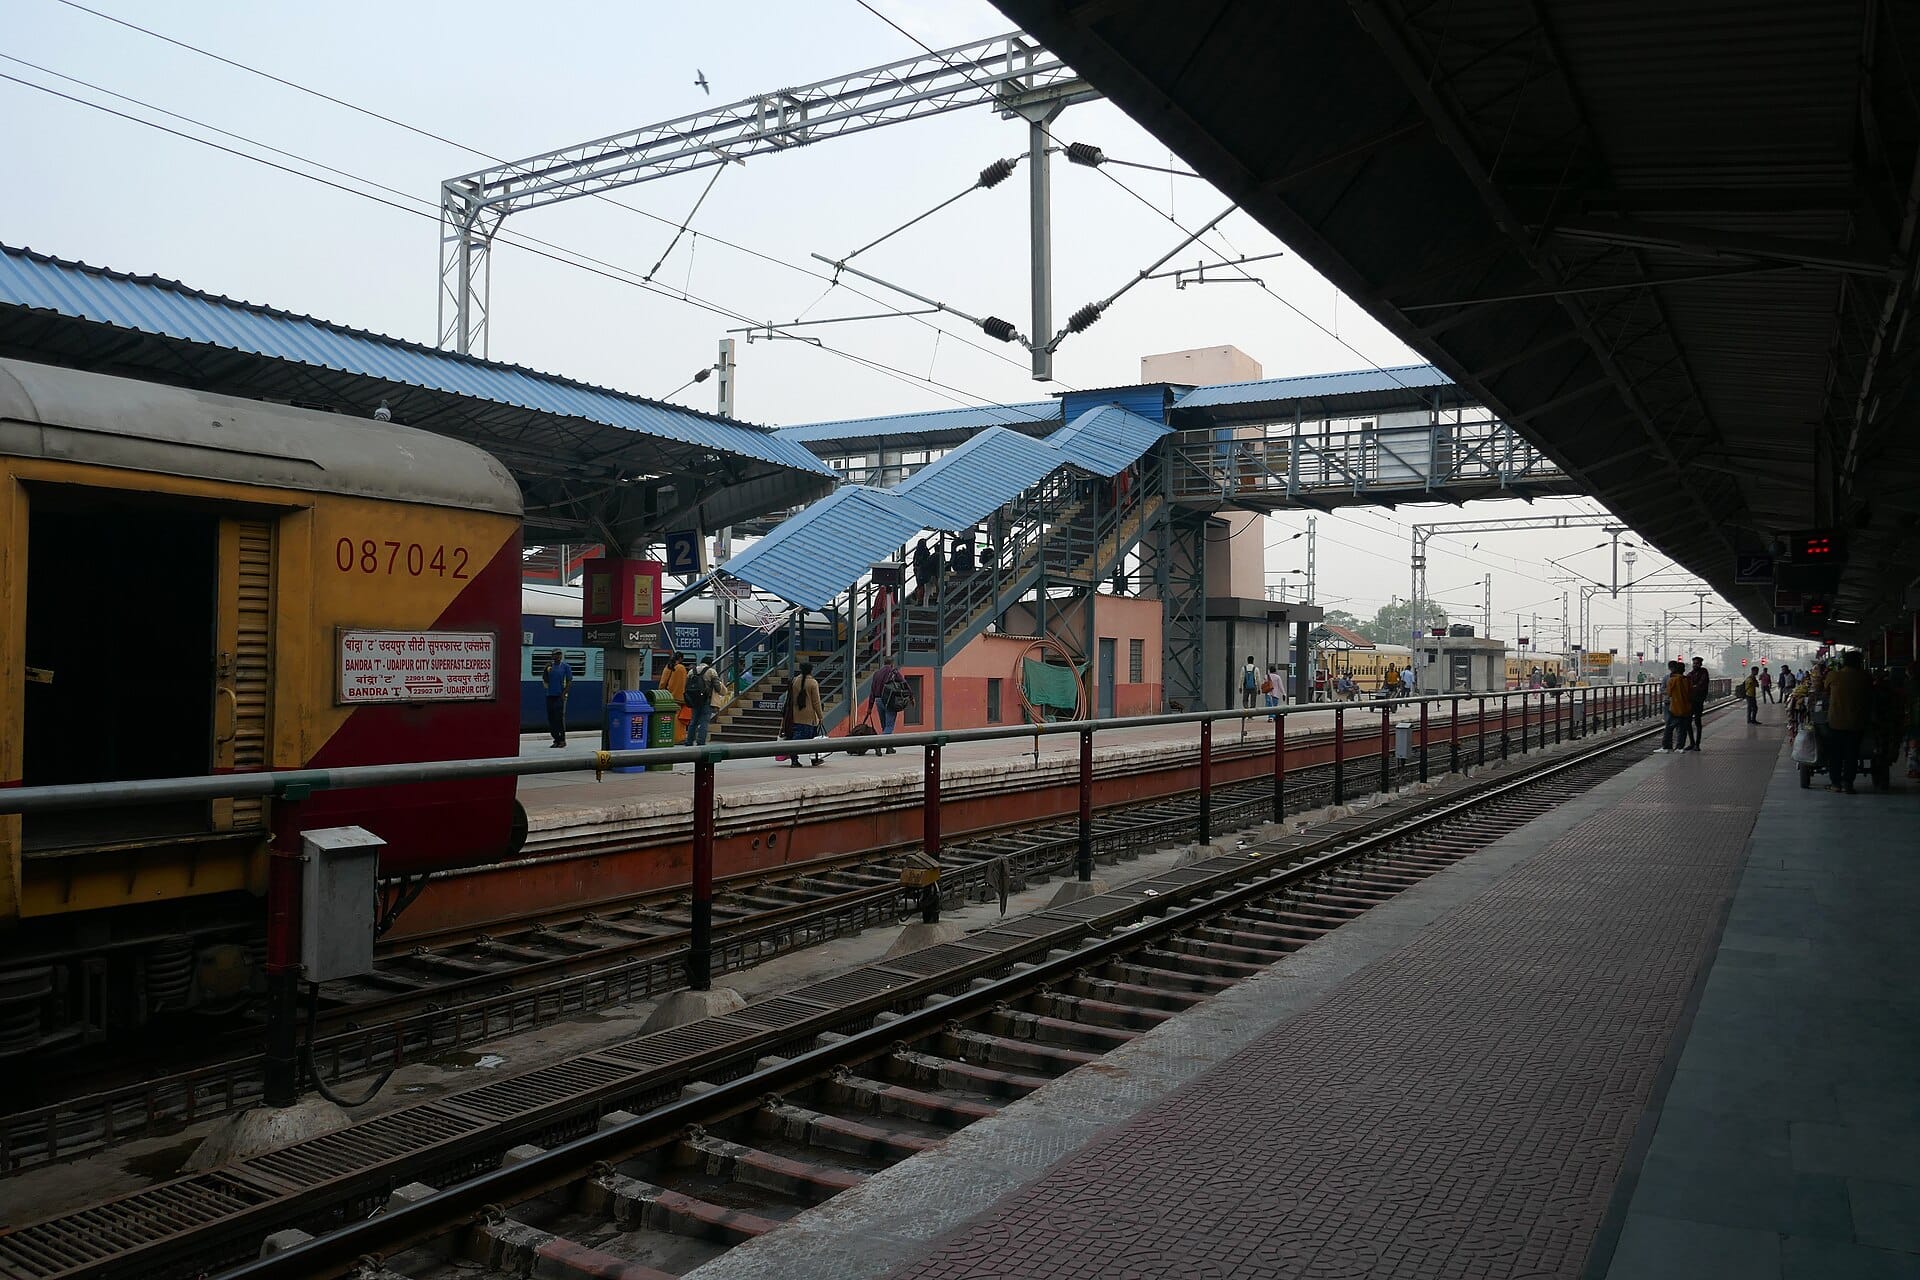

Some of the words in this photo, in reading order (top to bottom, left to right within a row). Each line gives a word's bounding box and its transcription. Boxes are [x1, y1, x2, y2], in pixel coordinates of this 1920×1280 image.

[336, 537, 469, 579] 087042
[675, 540, 692, 566] 2
[379, 640, 406, 656] उदयपुर
[408, 636, 425, 652] सीटी
[428, 640, 462, 656] सुपरफास्ट
[346, 659, 372, 671] BANDRA
[386, 659, 414, 671] UDAIPUR
[416, 659, 430, 670] CITY
[446, 675, 472, 685] उदयपुर
[473, 673, 490, 682] सीटी
[349, 688, 388, 696] BANDRA
[446, 686, 474, 694] UDAIPUR
[476, 686, 490, 694] CITY
